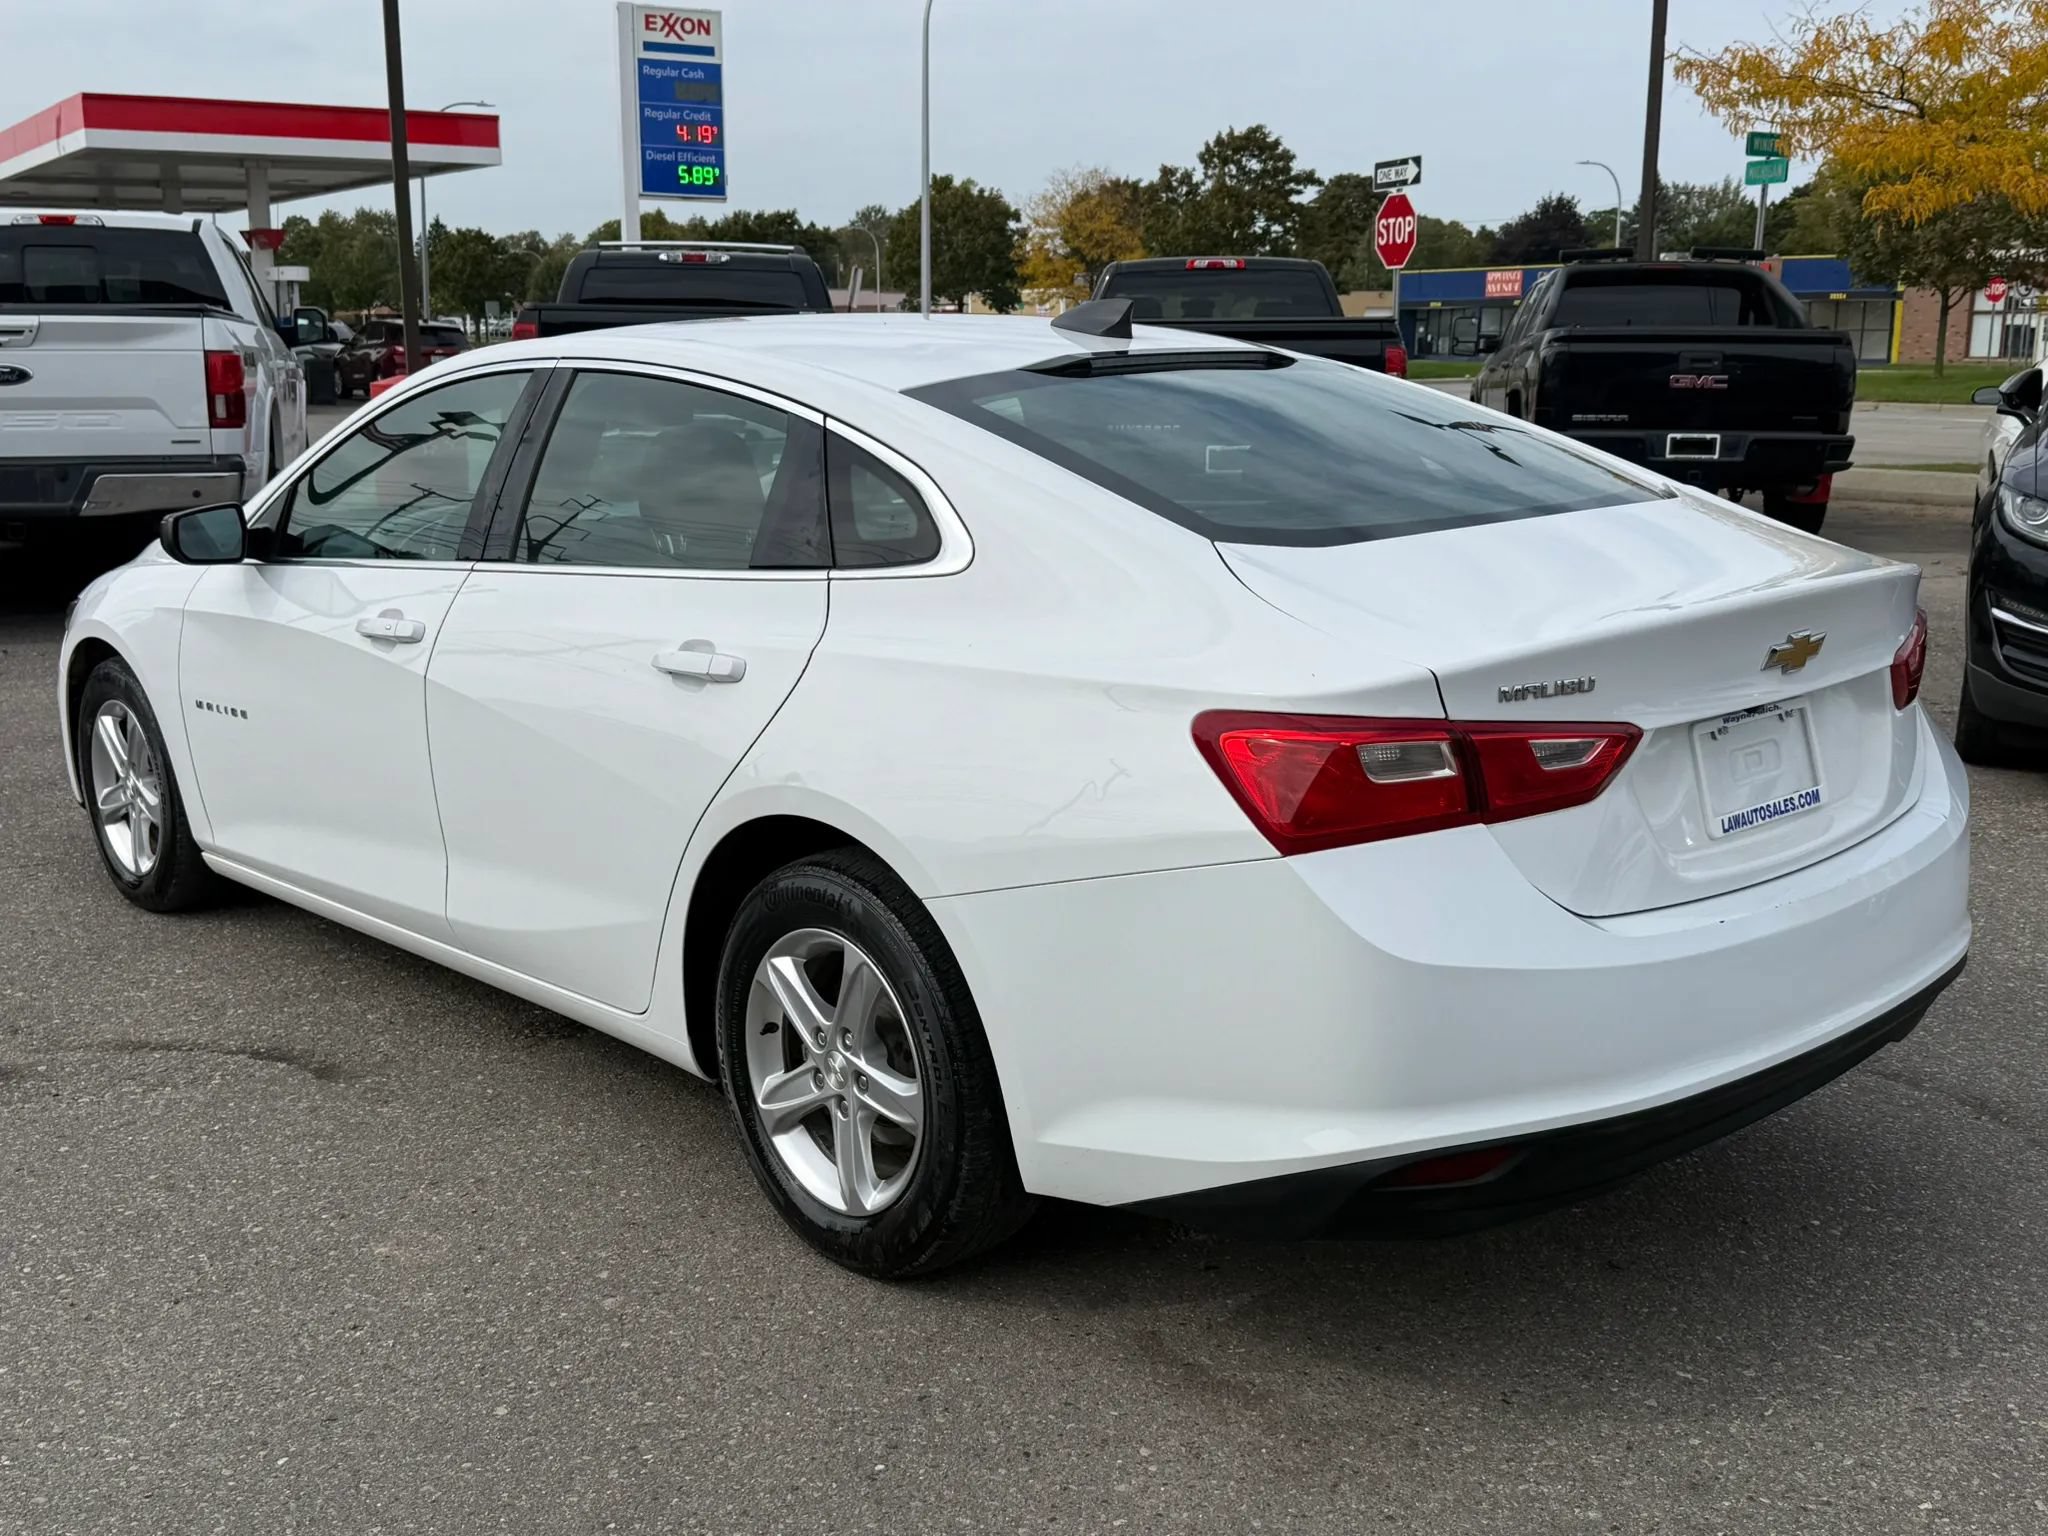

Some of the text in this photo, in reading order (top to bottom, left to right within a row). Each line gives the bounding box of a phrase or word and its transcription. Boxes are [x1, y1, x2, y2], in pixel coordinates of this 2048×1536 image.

[645, 12, 711, 42] EXXON
[643, 65, 705, 79] Regular Cash
[644, 107, 711, 121] Regular Credit
[646, 150, 716, 163] Diesel Efficient
[1378, 166, 1408, 182] ONE WAY
[1379, 215, 1414, 246] STOP
[1984, 283, 2006, 296] STOP
[1670, 374, 1728, 389] GMC
[1571, 414, 1629, 422] SIERRA
[1498, 676, 1595, 703] MALIBU
[195, 699, 248, 719] MALIBU
[1720, 788, 1821, 834] LAWAUTOSALES.COM
[765, 882, 844, 912] Continental
